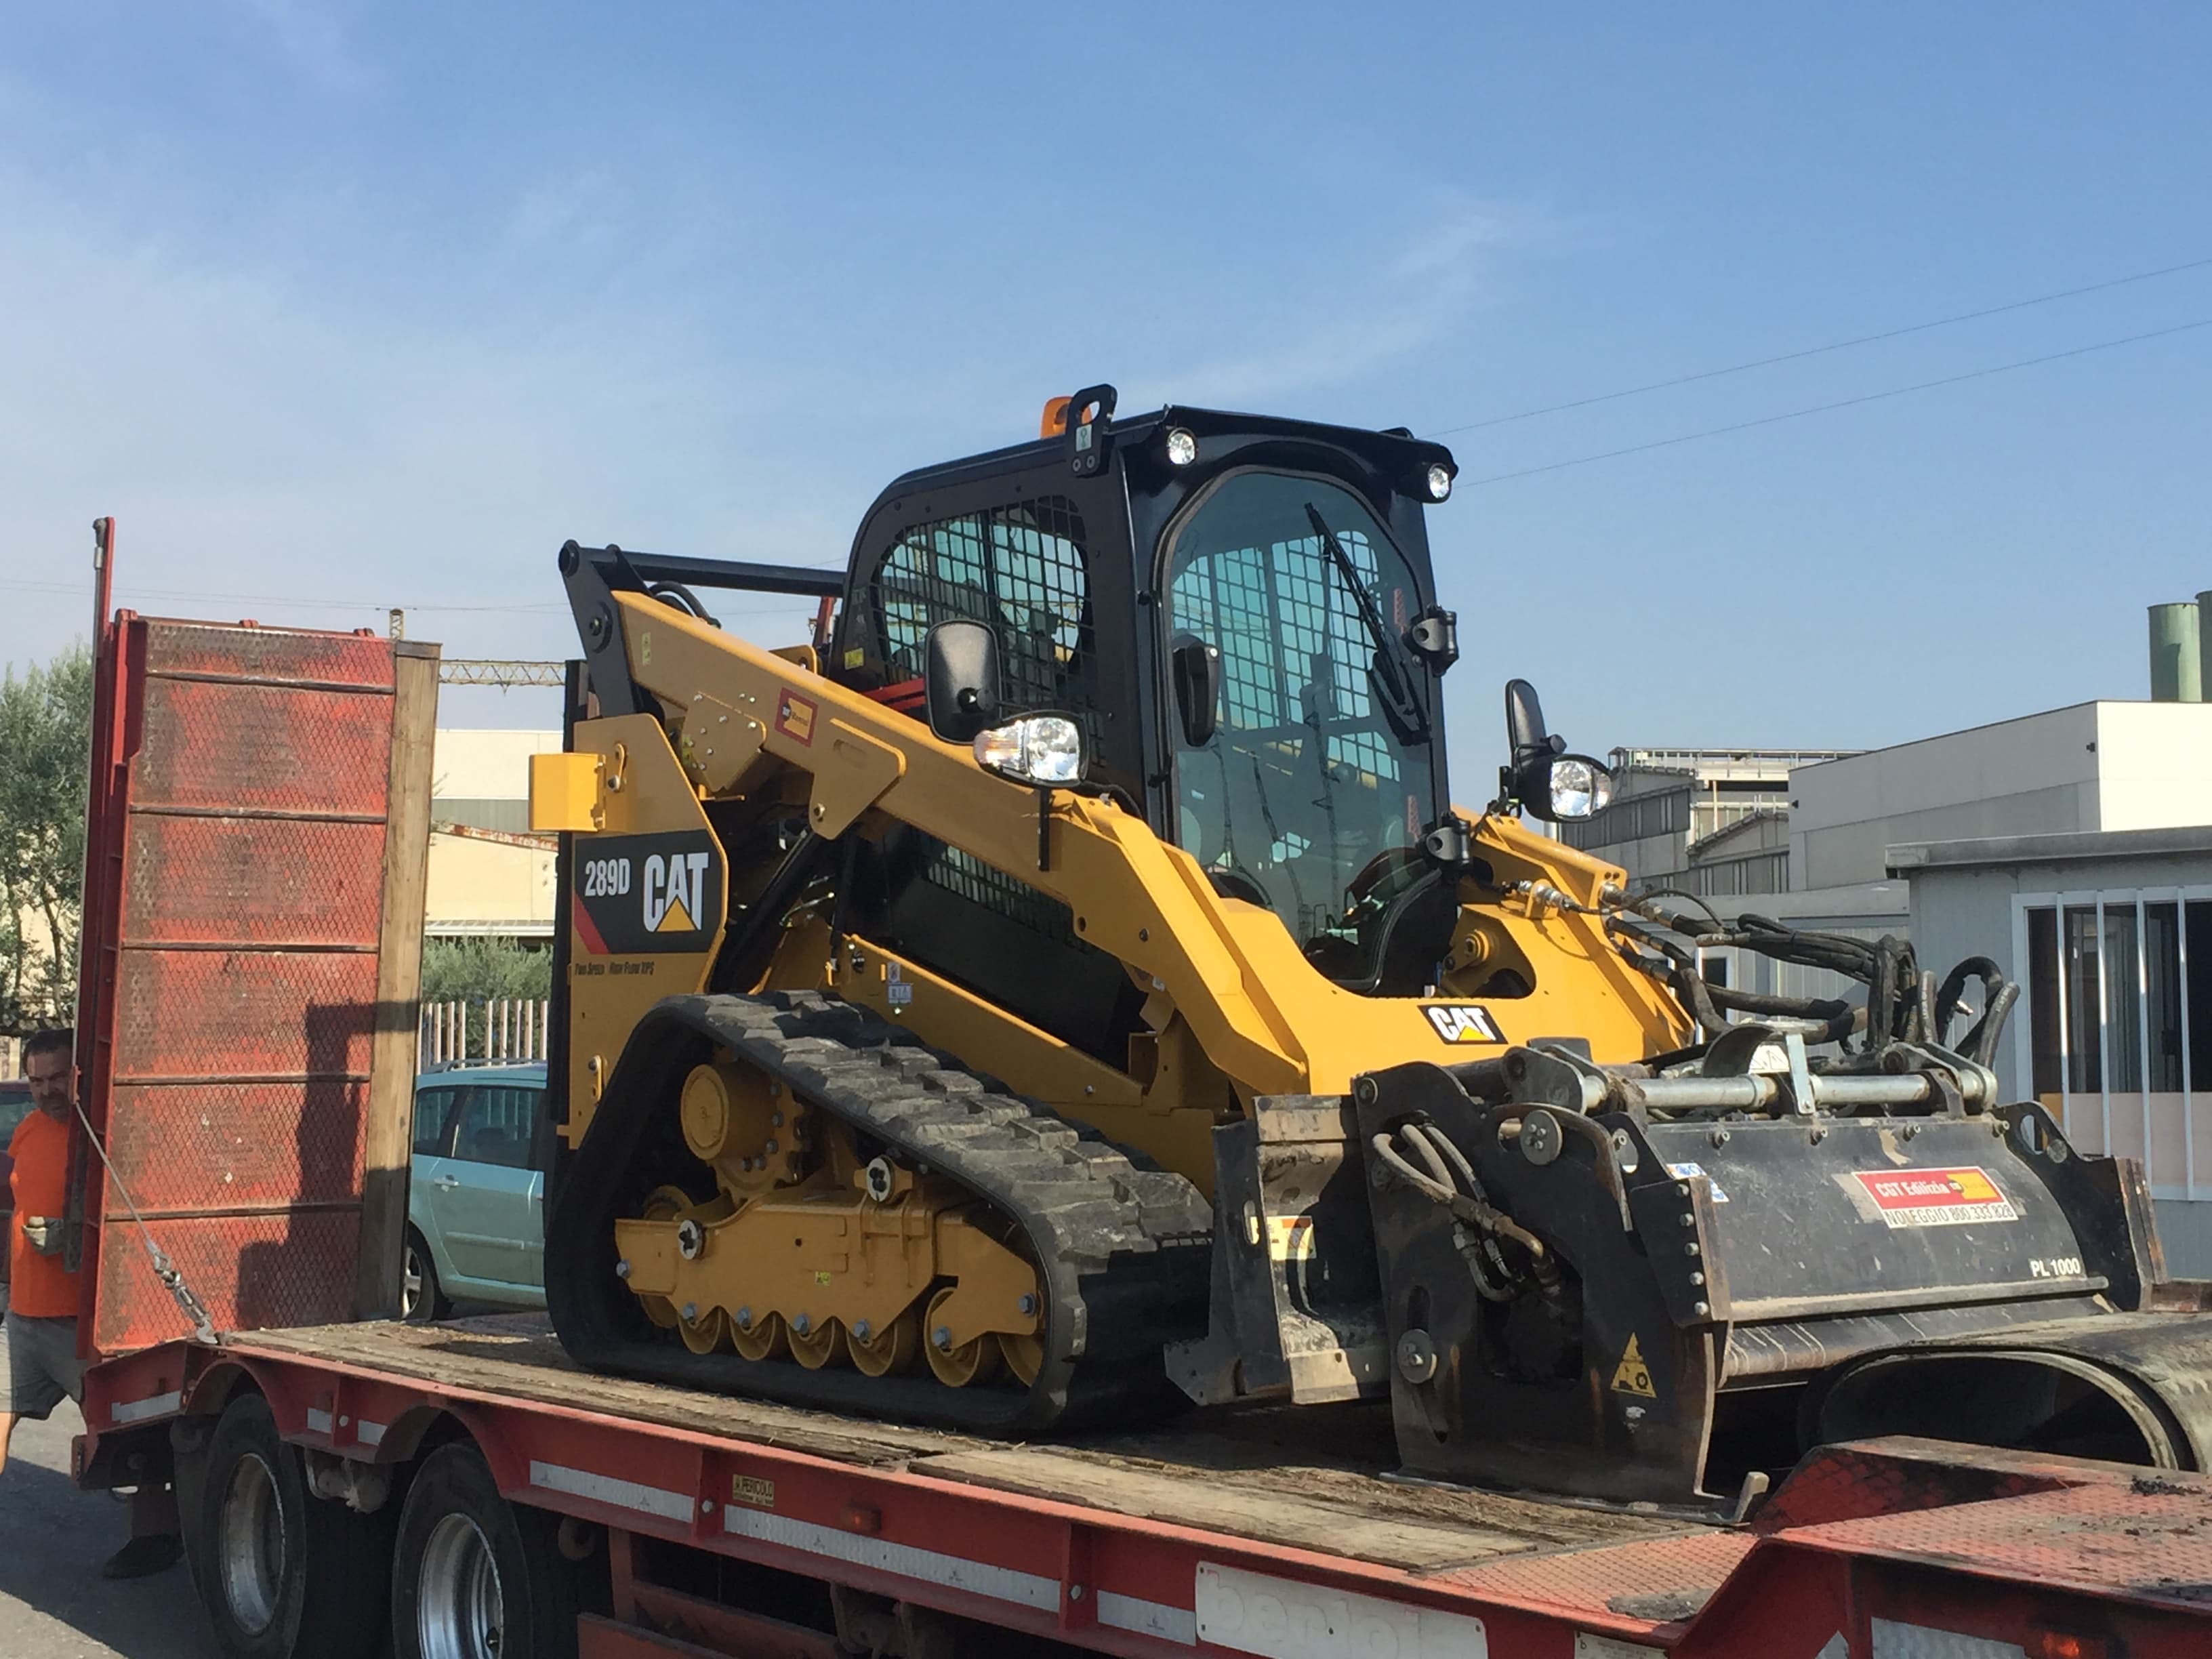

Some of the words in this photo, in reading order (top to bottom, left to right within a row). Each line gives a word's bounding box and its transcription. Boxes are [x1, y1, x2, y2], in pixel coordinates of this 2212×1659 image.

[585, 858, 631, 897] 289D
[644, 852, 709, 933] CAT
[1428, 1007, 1496, 1041] CAT
[1875, 1182, 1904, 1197] CGT
[1902, 1181, 1950, 1196] Edilizia
[1884, 1207, 1946, 1225] NOLEGGIO
[2030, 1260, 2051, 1277] PL
[2050, 1257, 2081, 1275] 1000
